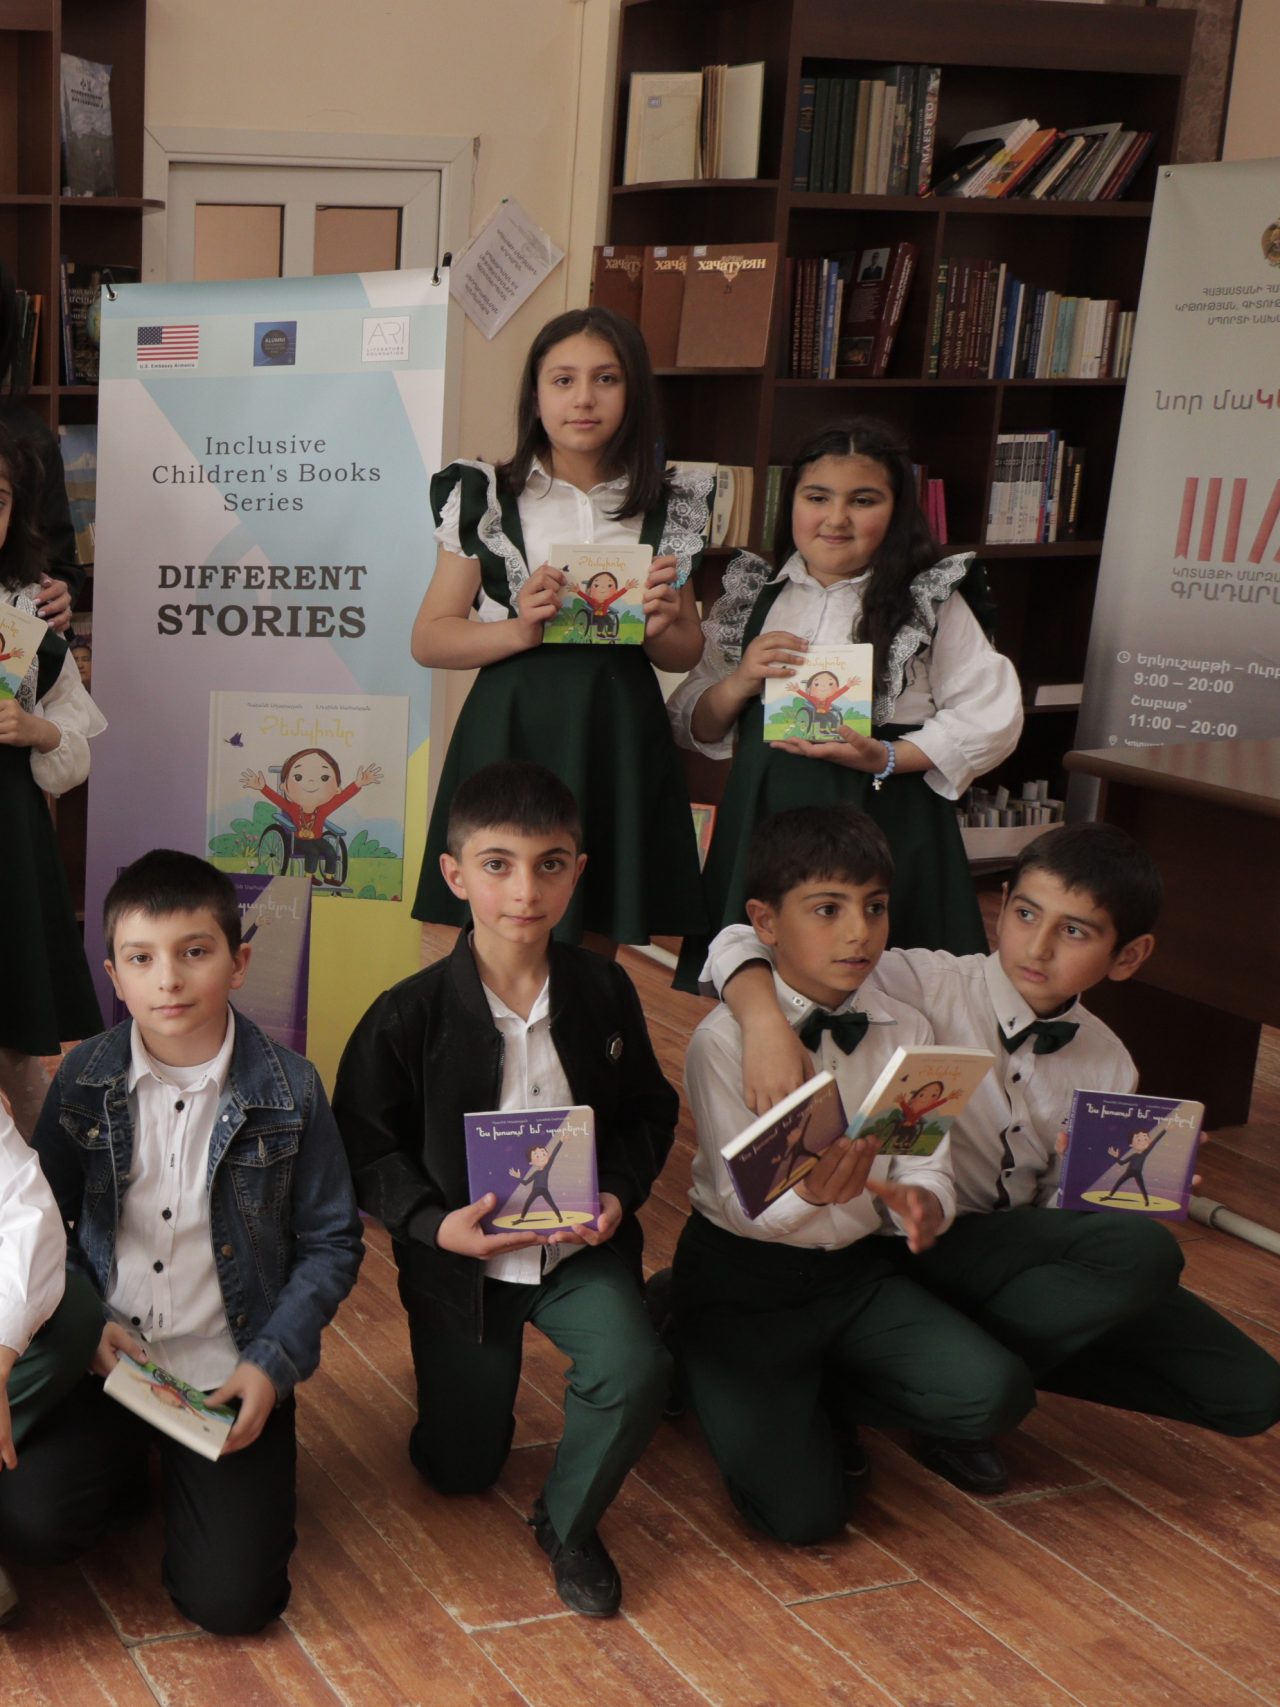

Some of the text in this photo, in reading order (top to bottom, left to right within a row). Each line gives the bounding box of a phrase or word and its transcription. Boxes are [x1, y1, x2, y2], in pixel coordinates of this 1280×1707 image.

[921, 102, 935, 163] MAESTRO
[1203, 286, 1262, 296] ՀԱՅԱՍՏԱՆԻ
[1208, 316, 1249, 325] ՍՊՈՐՏԻ
[368, 321, 405, 345] ARI
[1156, 390, 1203, 415] նոր
[205, 435, 327, 456] Inclusive
[152, 462, 381, 484] Children's Books
[224, 492, 304, 512] Series
[158, 565, 368, 590] DIFFERENT
[1172, 567, 1233, 579] ԿՈՏԱՅՔԻ
[157, 603, 366, 638] STORIES
[1137, 653, 1231, 674] Երկուշաբթի
[1134, 672, 1169, 687] 9:00
[1188, 677, 1234, 694] 20:00
[1129, 714, 1172, 730] 11:00
[1190, 720, 1238, 737] 20:00
